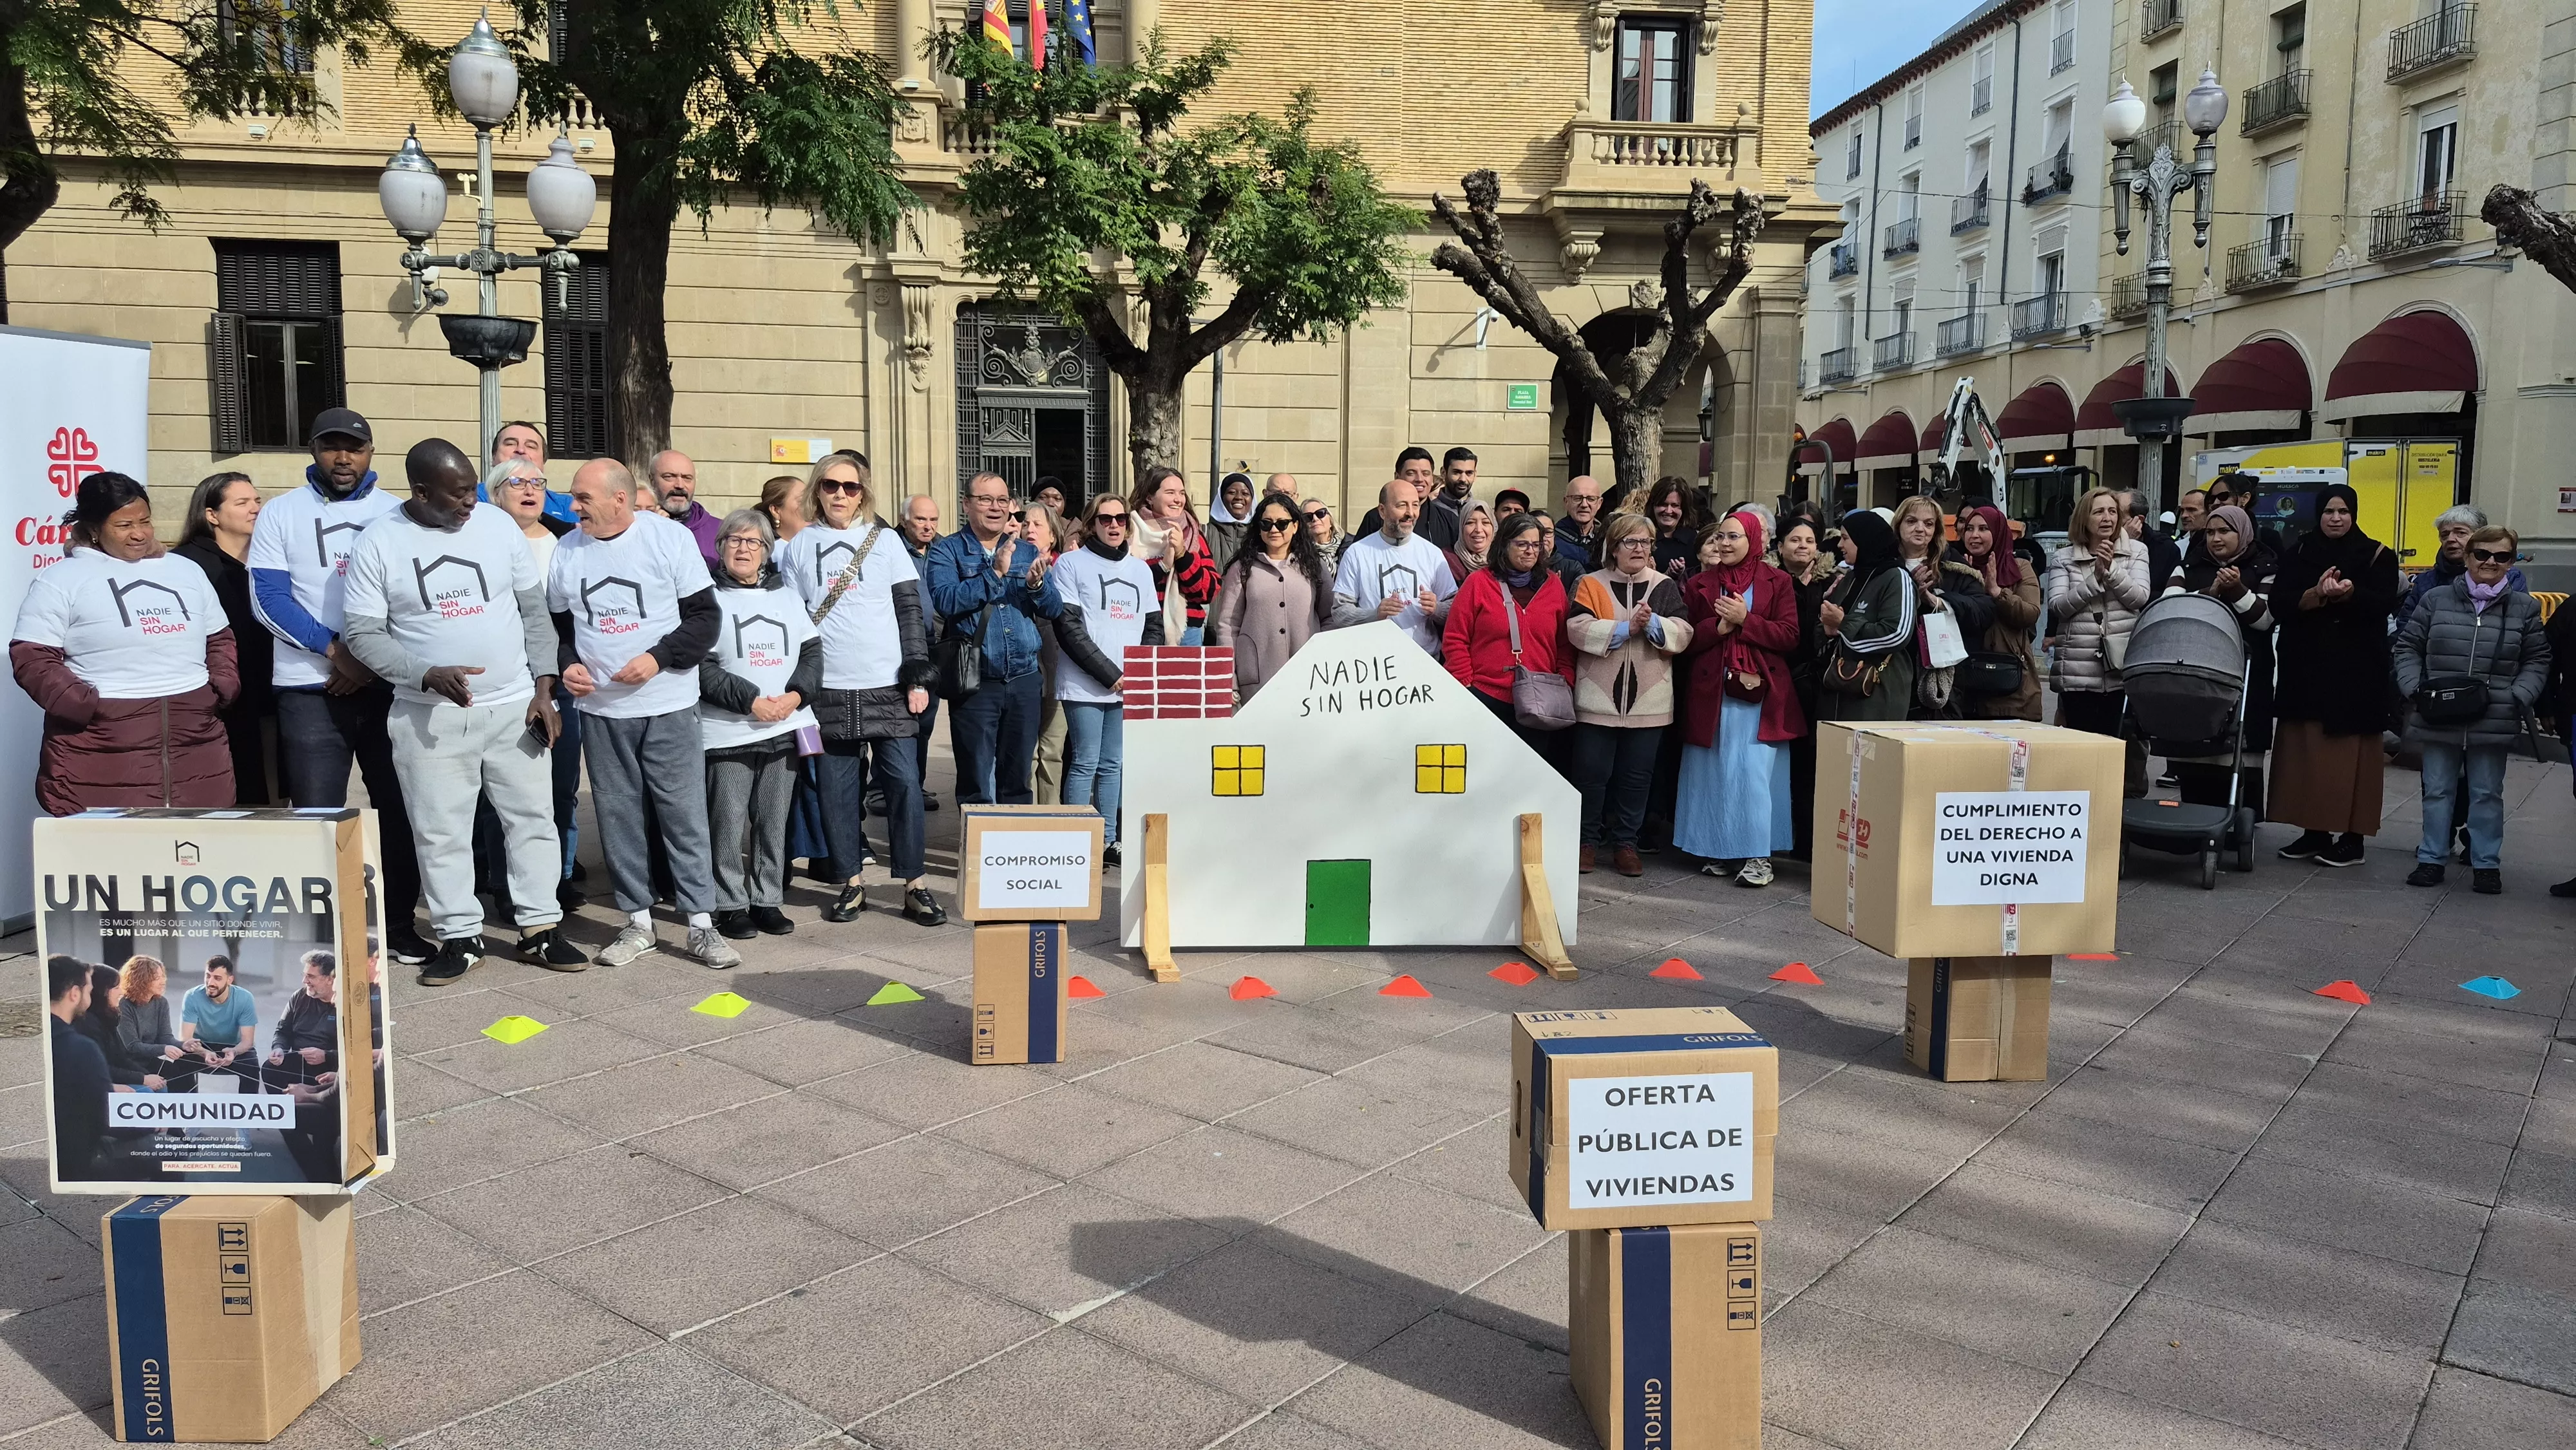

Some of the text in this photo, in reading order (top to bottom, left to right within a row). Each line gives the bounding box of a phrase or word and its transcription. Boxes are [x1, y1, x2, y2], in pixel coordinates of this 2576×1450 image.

[2220, 465, 2239, 474] makro
[436, 588, 471, 601] NADIE
[439, 600, 459, 609] SIN
[136, 608, 172, 617] NADIE
[442, 606, 484, 618] HOGAR
[598, 607, 629, 617] NADIE
[140, 616, 161, 626] SIN
[600, 617, 616, 626] SIN
[143, 624, 186, 635] HOGAR
[601, 623, 639, 634] HOGAR
[1310, 655, 1397, 691] NADIE
[1300, 684, 1434, 717] SIN HOGAR
[1943, 804, 2082, 817] CUMPLIMIENTO
[1940, 827, 2082, 841] DEL DERECHO A
[984, 855, 1085, 866] COMPROMISO
[1947, 850, 2074, 863] UNA VIVIENDA
[1007, 879, 1063, 890] SOCIAL
[1980, 873, 2039, 886] DIGNA
[44, 874, 118, 911] UN
[142, 874, 333, 914] HOGAR
[147, 918, 166, 927] MÁS
[100, 928, 113, 937] ES
[117, 928, 131, 937] UN
[134, 929, 169, 937] LUGAR
[188, 929, 209, 937] QUE
[213, 930, 283, 938] PERTENECER.
[1035, 930, 1046, 978] GRIFOLS
[1683, 1035, 1764, 1043] GRIFOLS
[1605, 1084, 1716, 1107] OFERTA
[117, 1102, 285, 1120] COMUNIDAD
[1578, 1128, 1743, 1153] PÚBLICA DE
[1586, 1173, 1735, 1198] VIVIENDAS
[142, 1359, 164, 1436] GRIFOLS
